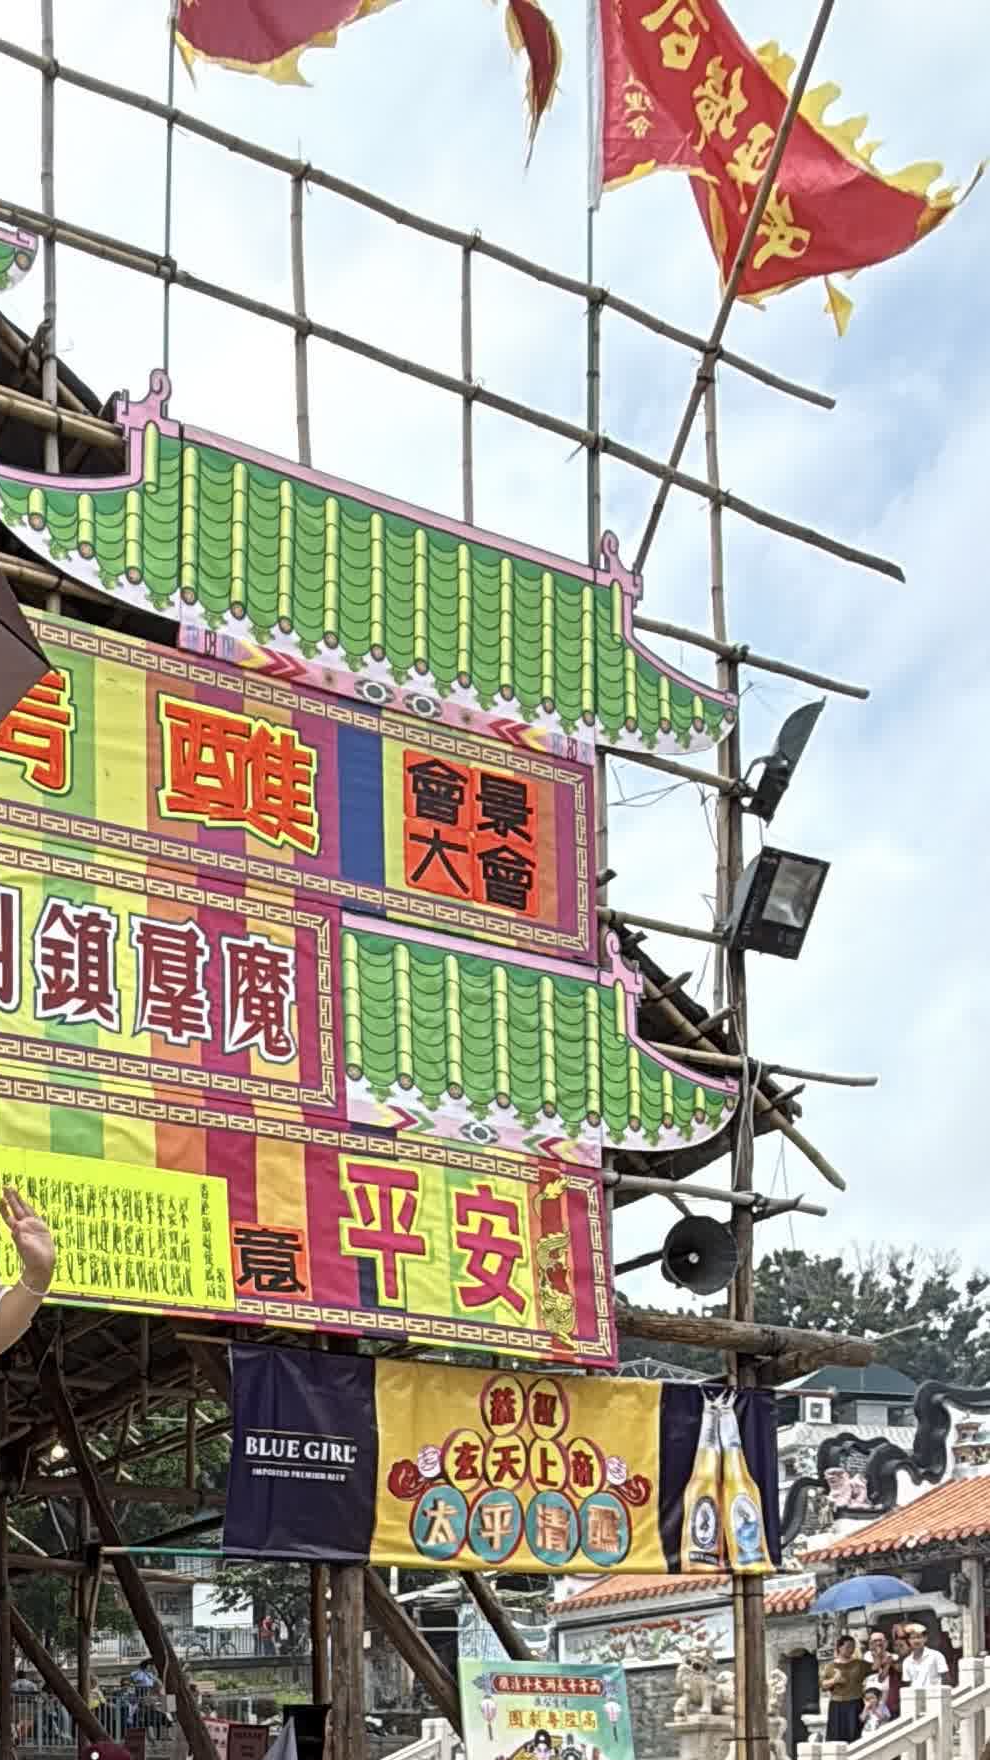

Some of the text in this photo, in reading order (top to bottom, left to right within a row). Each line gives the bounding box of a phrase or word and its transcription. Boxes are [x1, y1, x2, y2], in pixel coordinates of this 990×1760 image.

[345, 1160, 528, 1316] 平安
[245, 1436, 357, 1464] BLUE GIRL
[453, 1441, 596, 1489] 玄天上帝
[422, 1498, 622, 1553] 太平清醮
